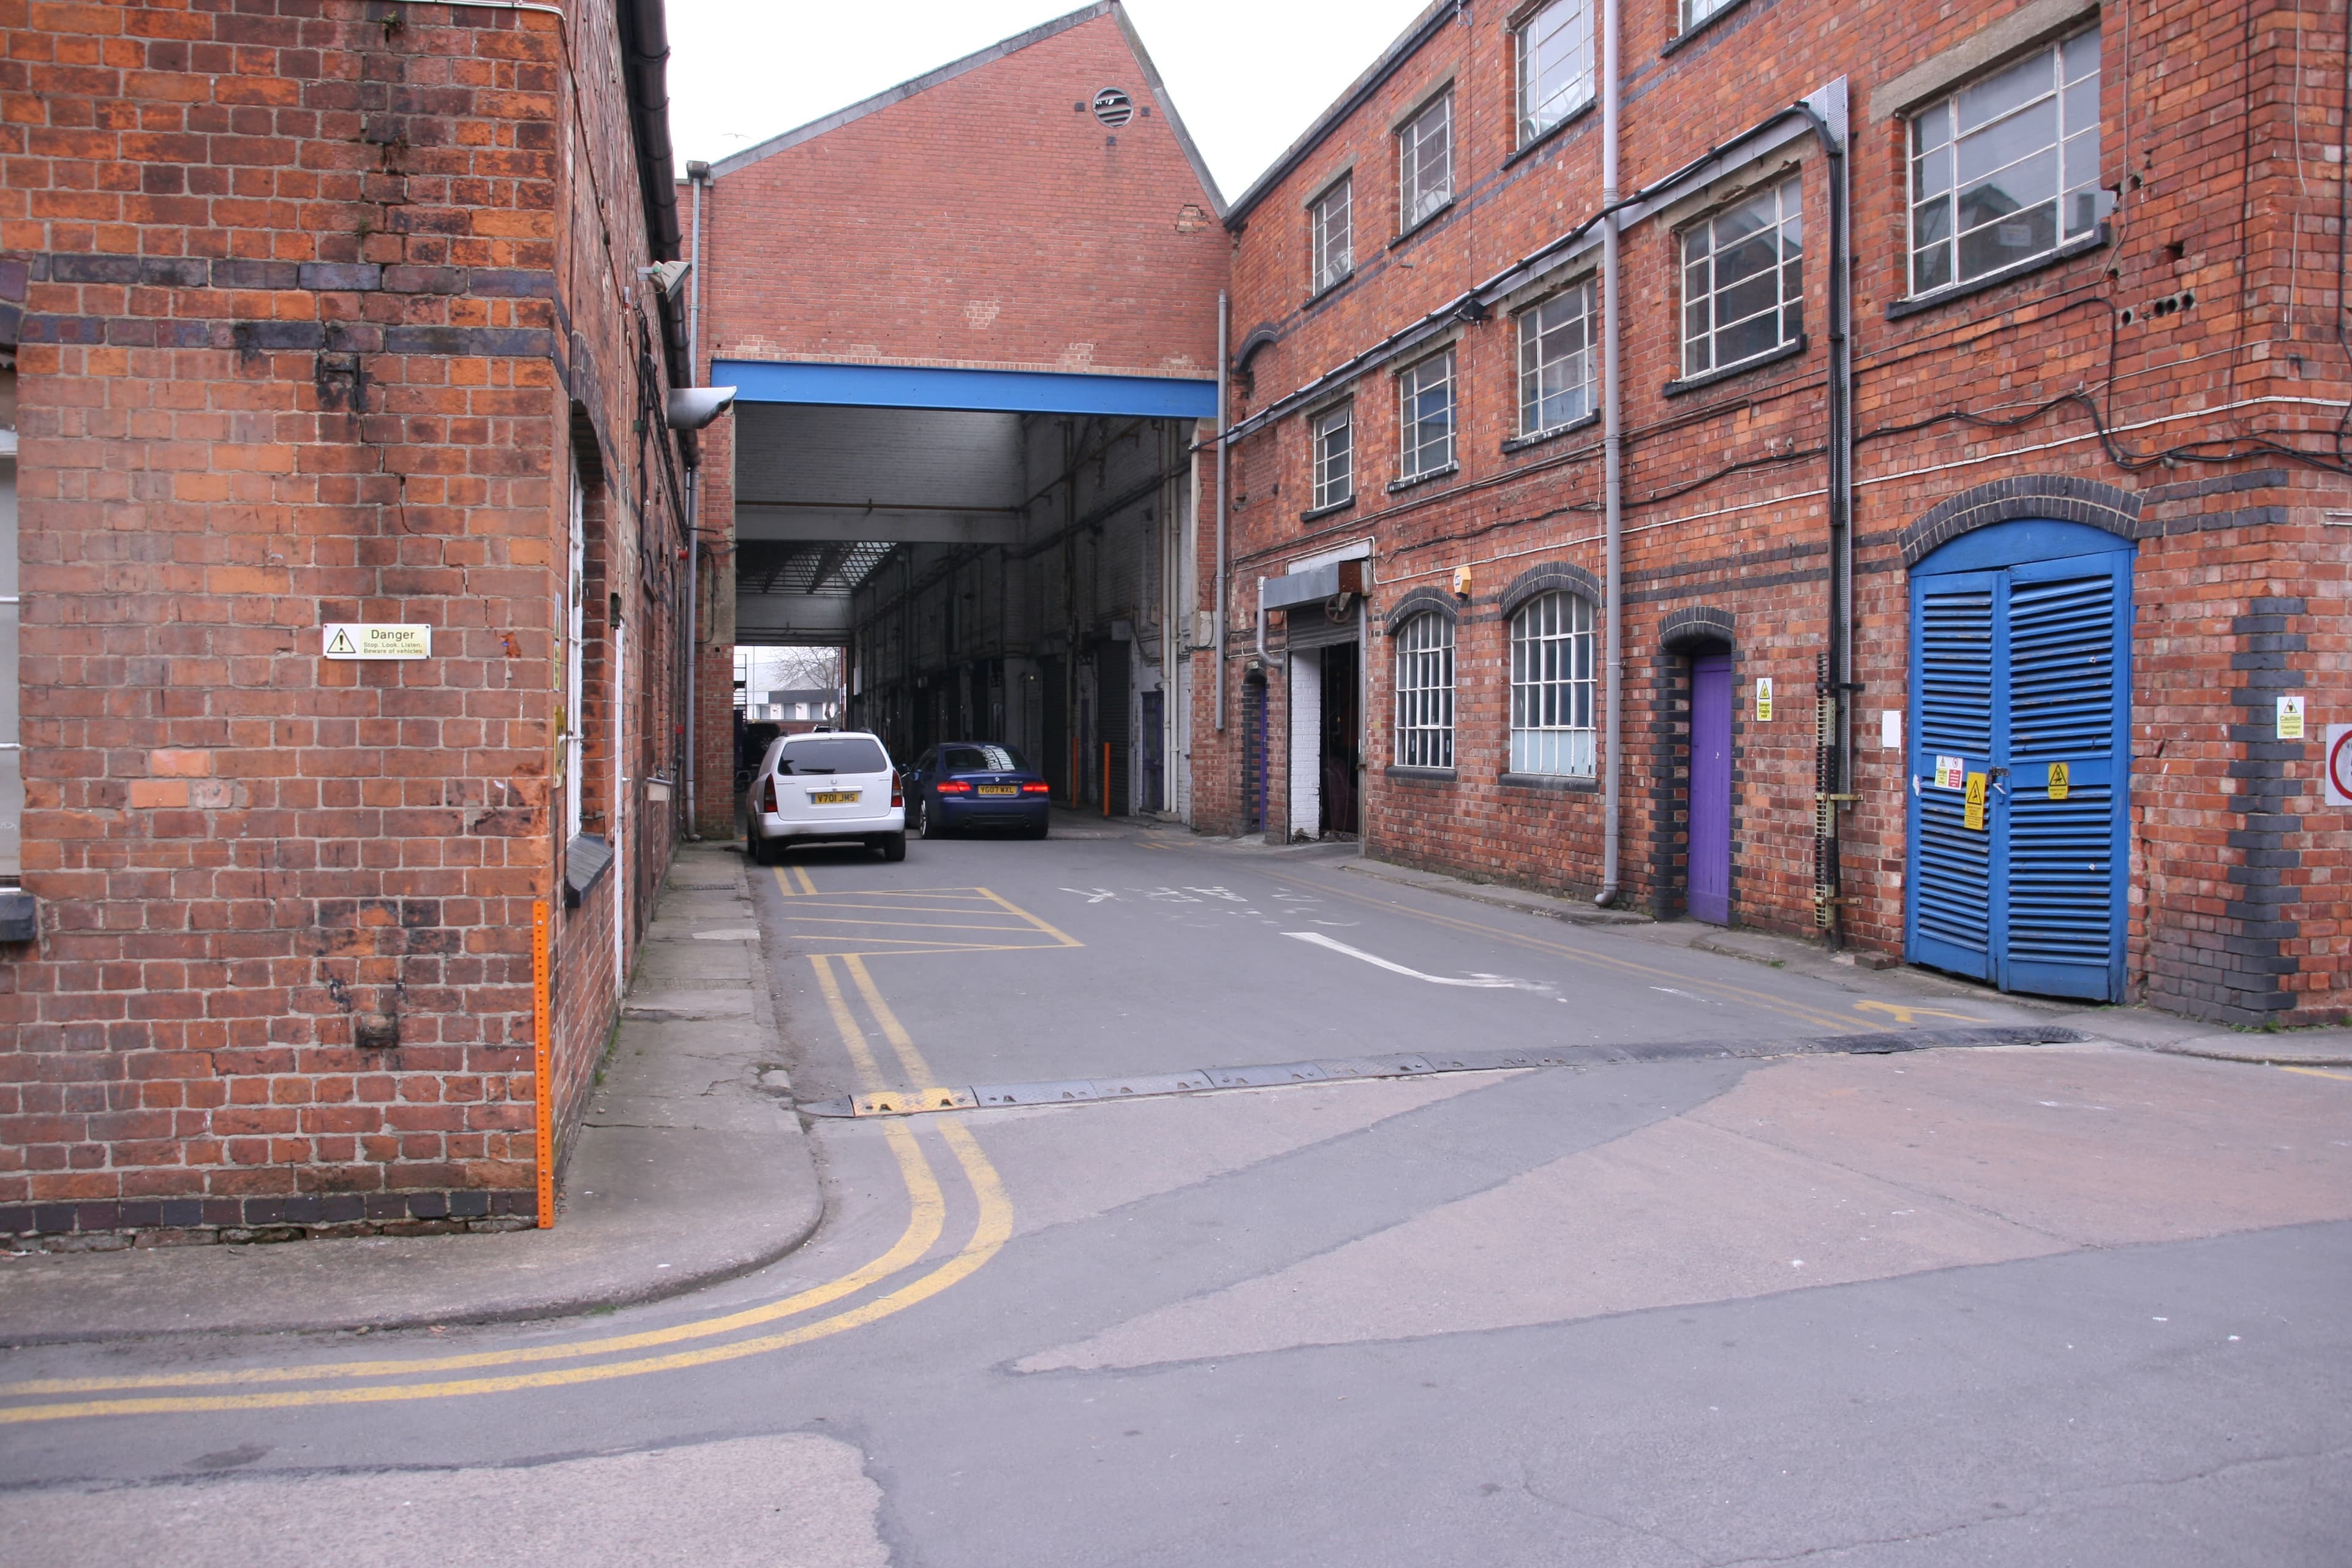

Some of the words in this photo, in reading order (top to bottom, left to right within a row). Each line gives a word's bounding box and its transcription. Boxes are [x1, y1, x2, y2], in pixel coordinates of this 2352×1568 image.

[371, 629, 415, 642] Danger
[818, 794, 837, 802] V701
[839, 793, 855, 802] JMS
